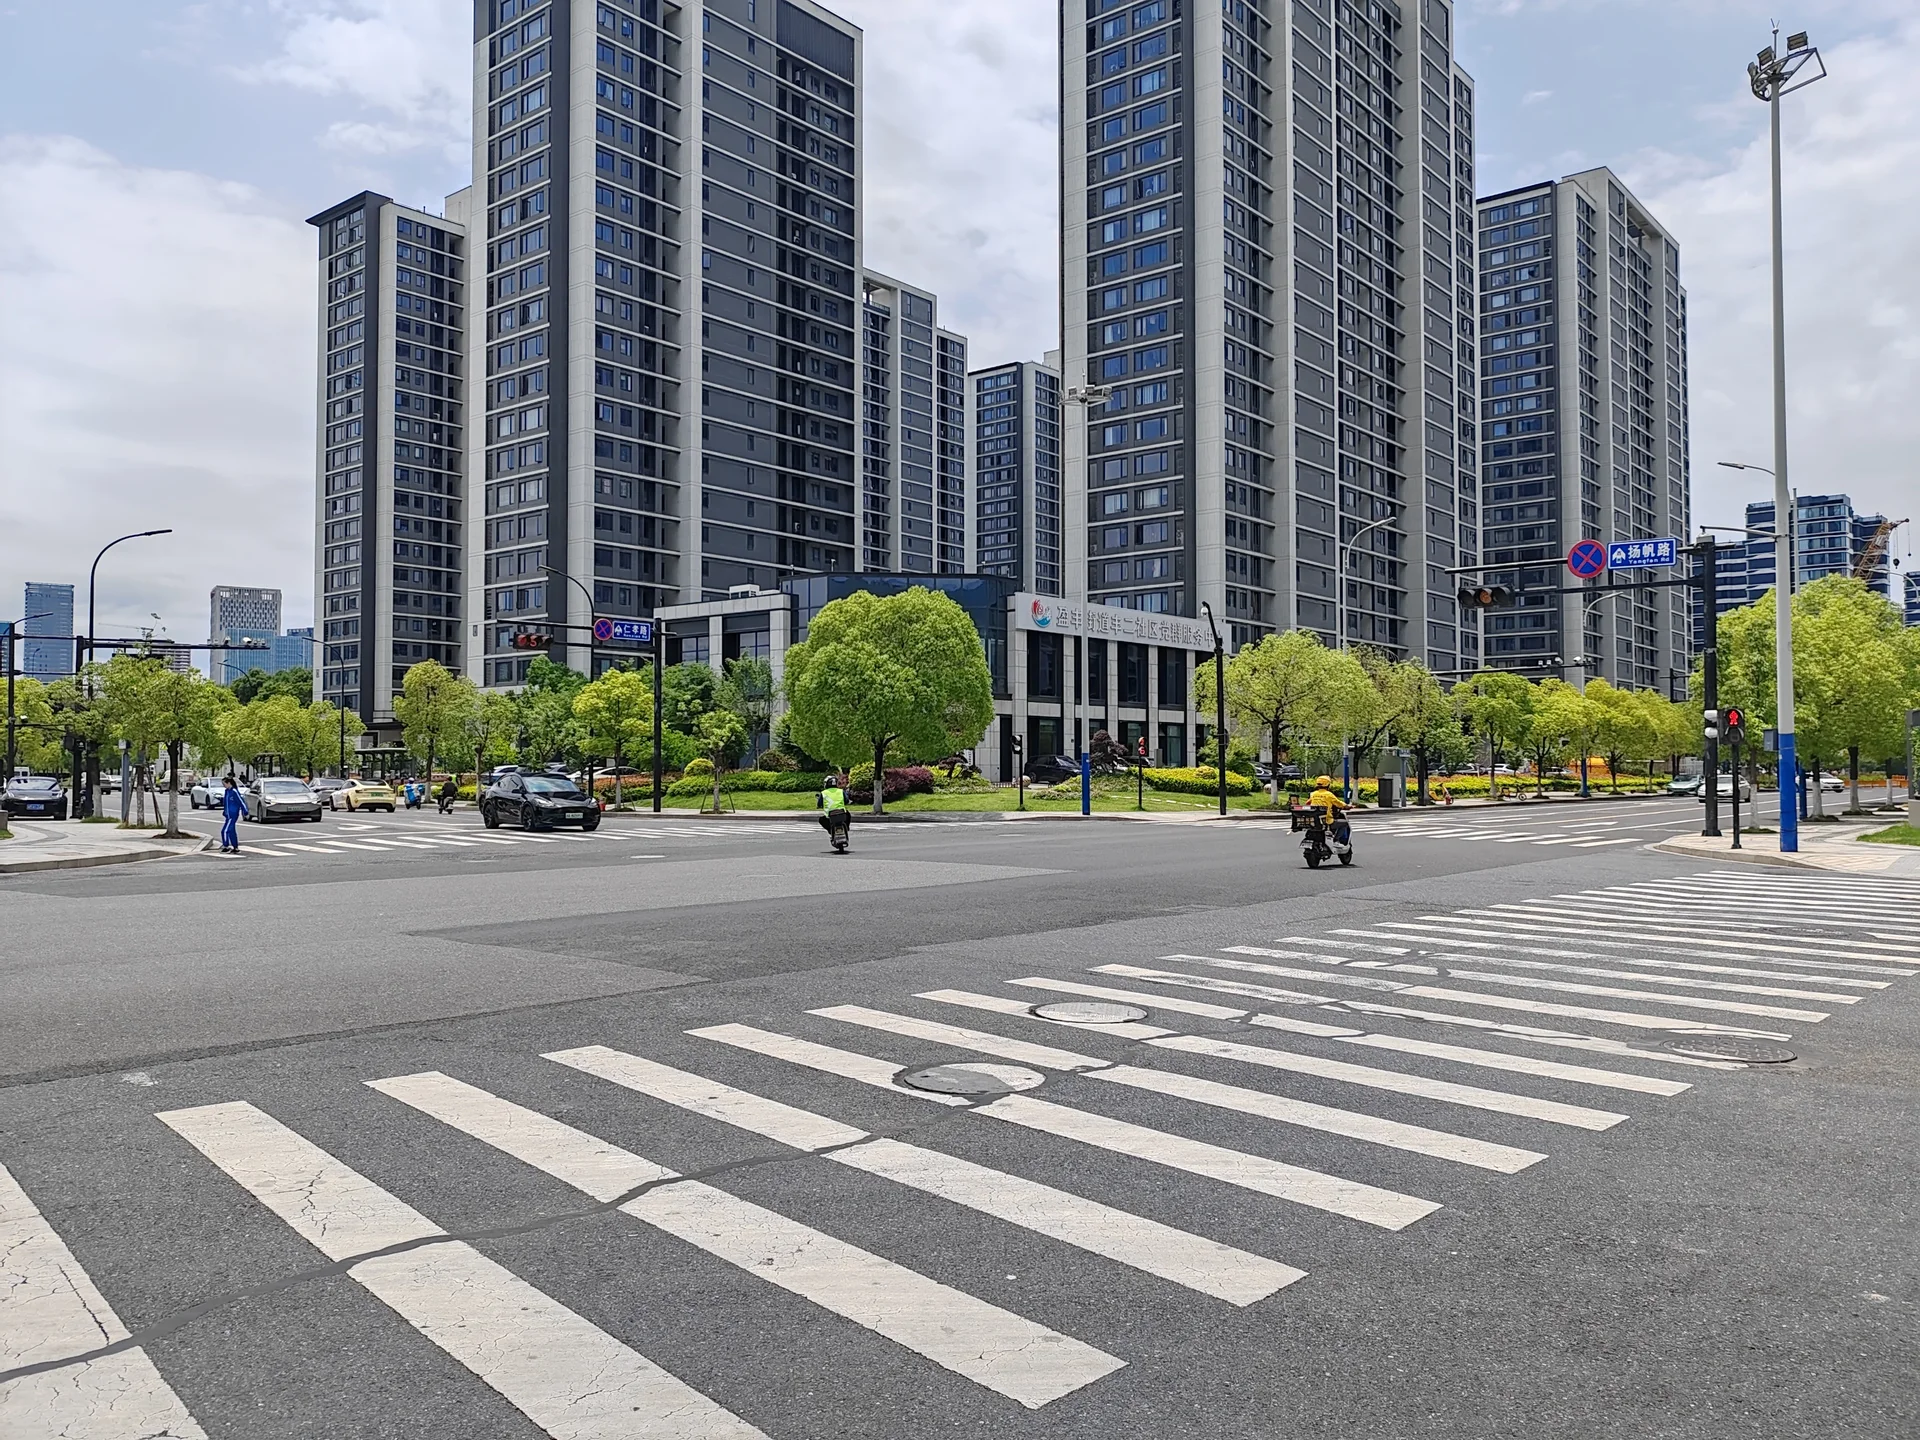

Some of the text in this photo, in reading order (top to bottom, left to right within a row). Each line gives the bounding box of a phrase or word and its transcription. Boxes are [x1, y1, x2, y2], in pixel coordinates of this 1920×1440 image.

[1628, 542, 1670, 558] 扬帆路
[623, 624, 647, 635] 仁孝路
